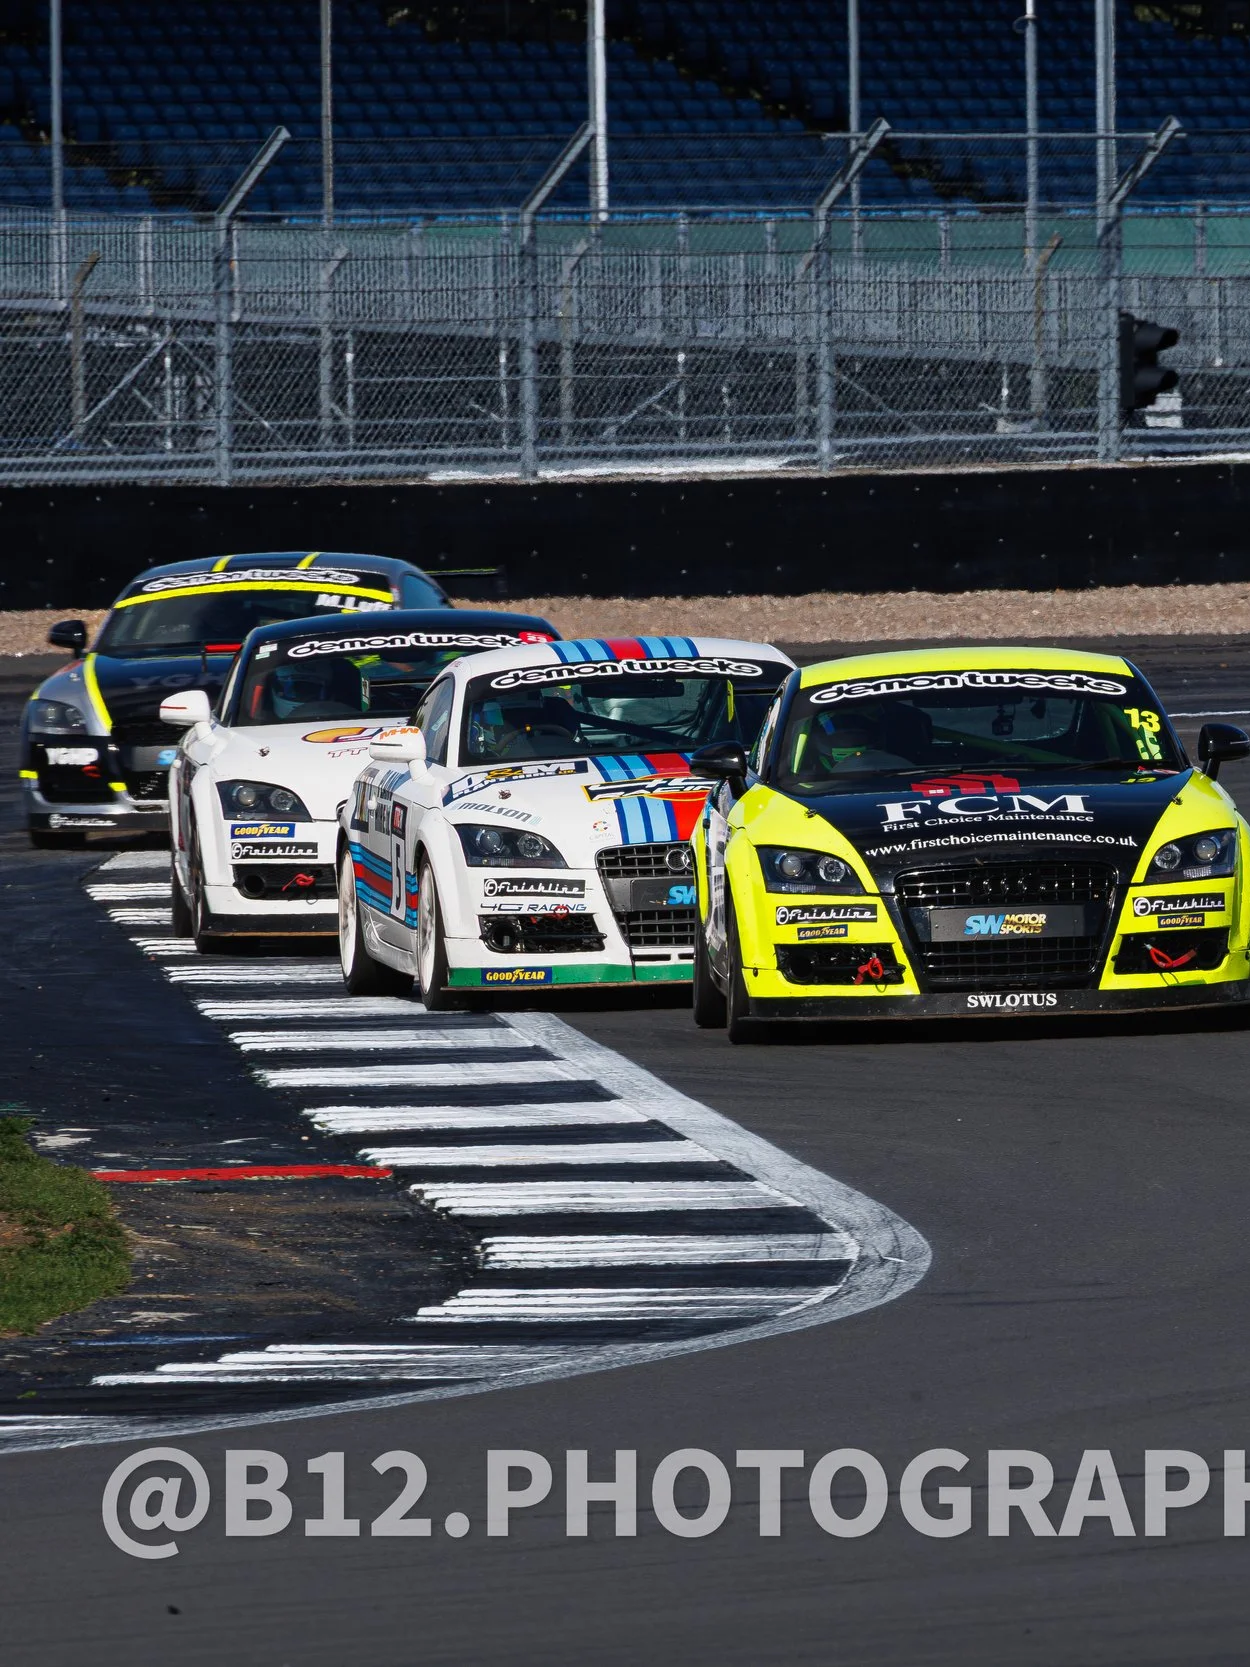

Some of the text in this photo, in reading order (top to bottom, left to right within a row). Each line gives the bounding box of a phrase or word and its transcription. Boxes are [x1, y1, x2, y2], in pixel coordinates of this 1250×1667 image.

[1123, 708, 1161, 732] 13
[876, 794, 1094, 824] FCM
[883, 813, 1094, 832] First Choice Maintenance
[234, 824, 291, 836] GOODYEAR
[242, 844, 318, 856] Finishline
[865, 830, 1138, 857] www.firstchoicemaintenance.co.uk
[497, 882, 585, 895] Finishline
[527, 902, 588, 912] RACING
[1151, 898, 1224, 911] Finishline
[788, 907, 876, 920] Finishline
[1160, 914, 1203, 926] GOODYEAR
[964, 913, 1047, 935] SW MOTOR
[1000, 923, 1043, 934] SPORTS
[800, 925, 846, 938] GOODYEAR
[486, 968, 545, 983] GOODYEAR
